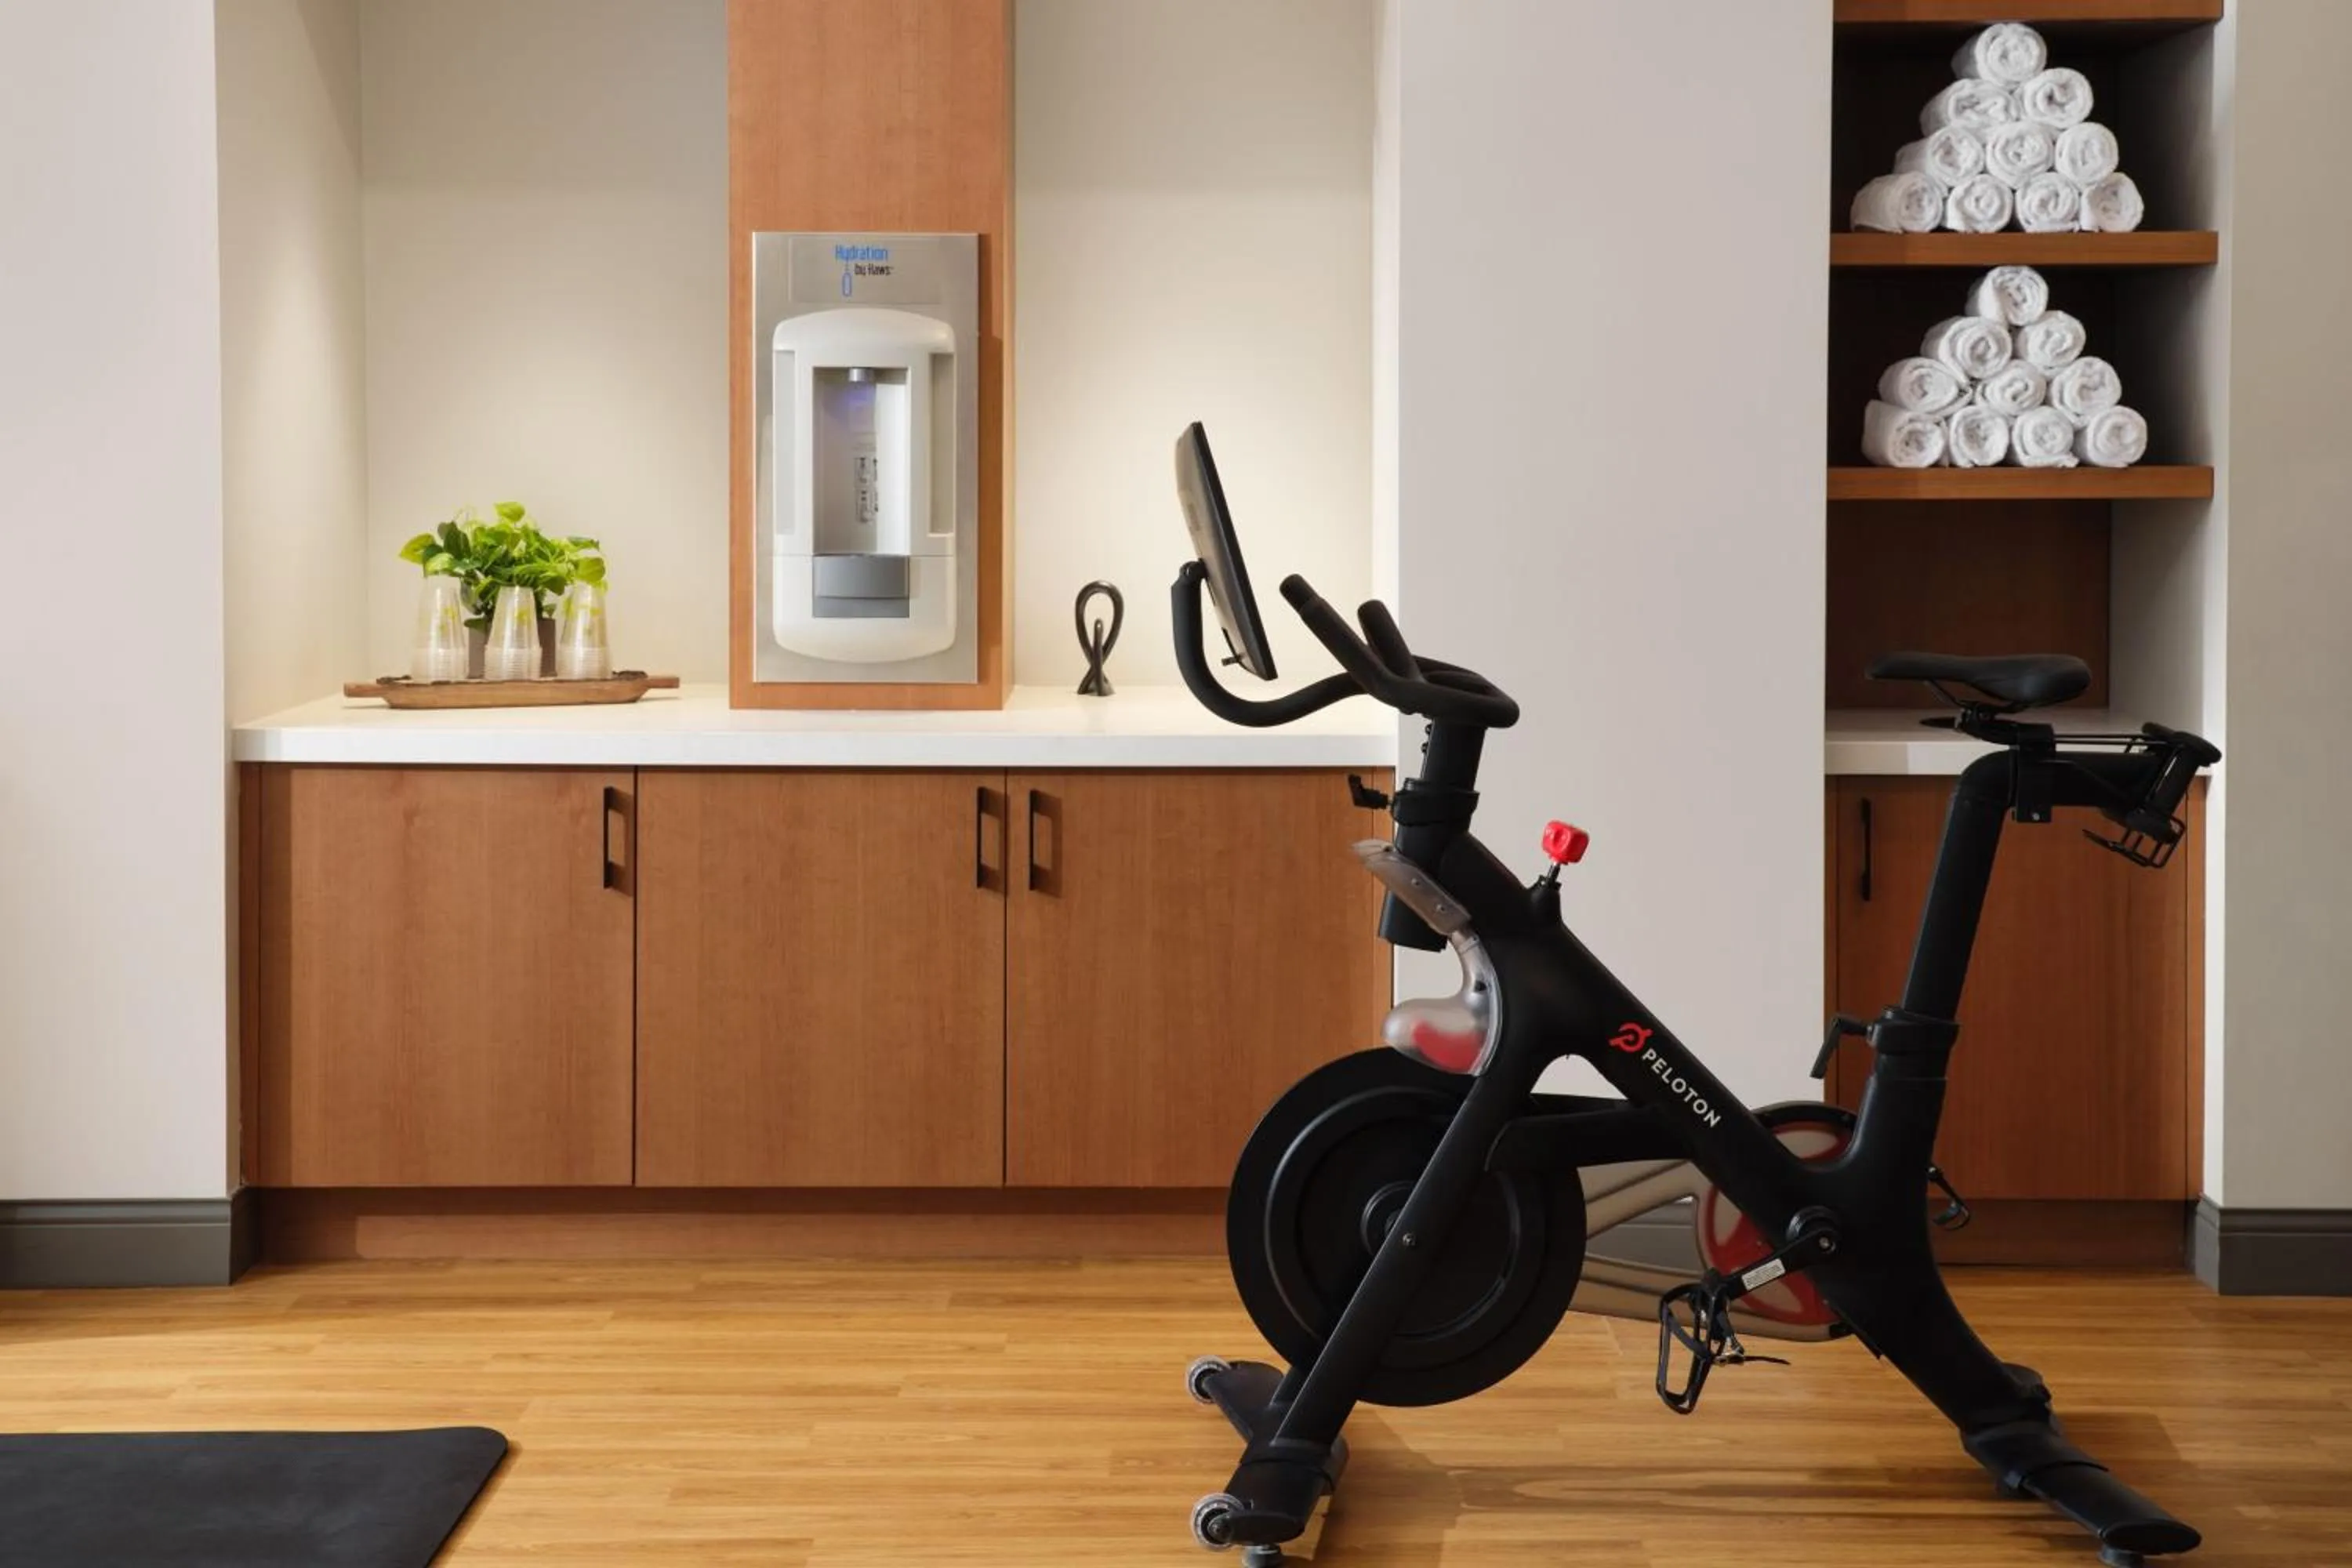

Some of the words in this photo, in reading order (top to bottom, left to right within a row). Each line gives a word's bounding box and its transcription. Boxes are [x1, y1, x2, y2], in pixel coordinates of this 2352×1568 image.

[835, 245, 888, 261] Hydration
[855, 263, 866, 277] by
[1642, 1047, 1722, 1127] PELOTON
